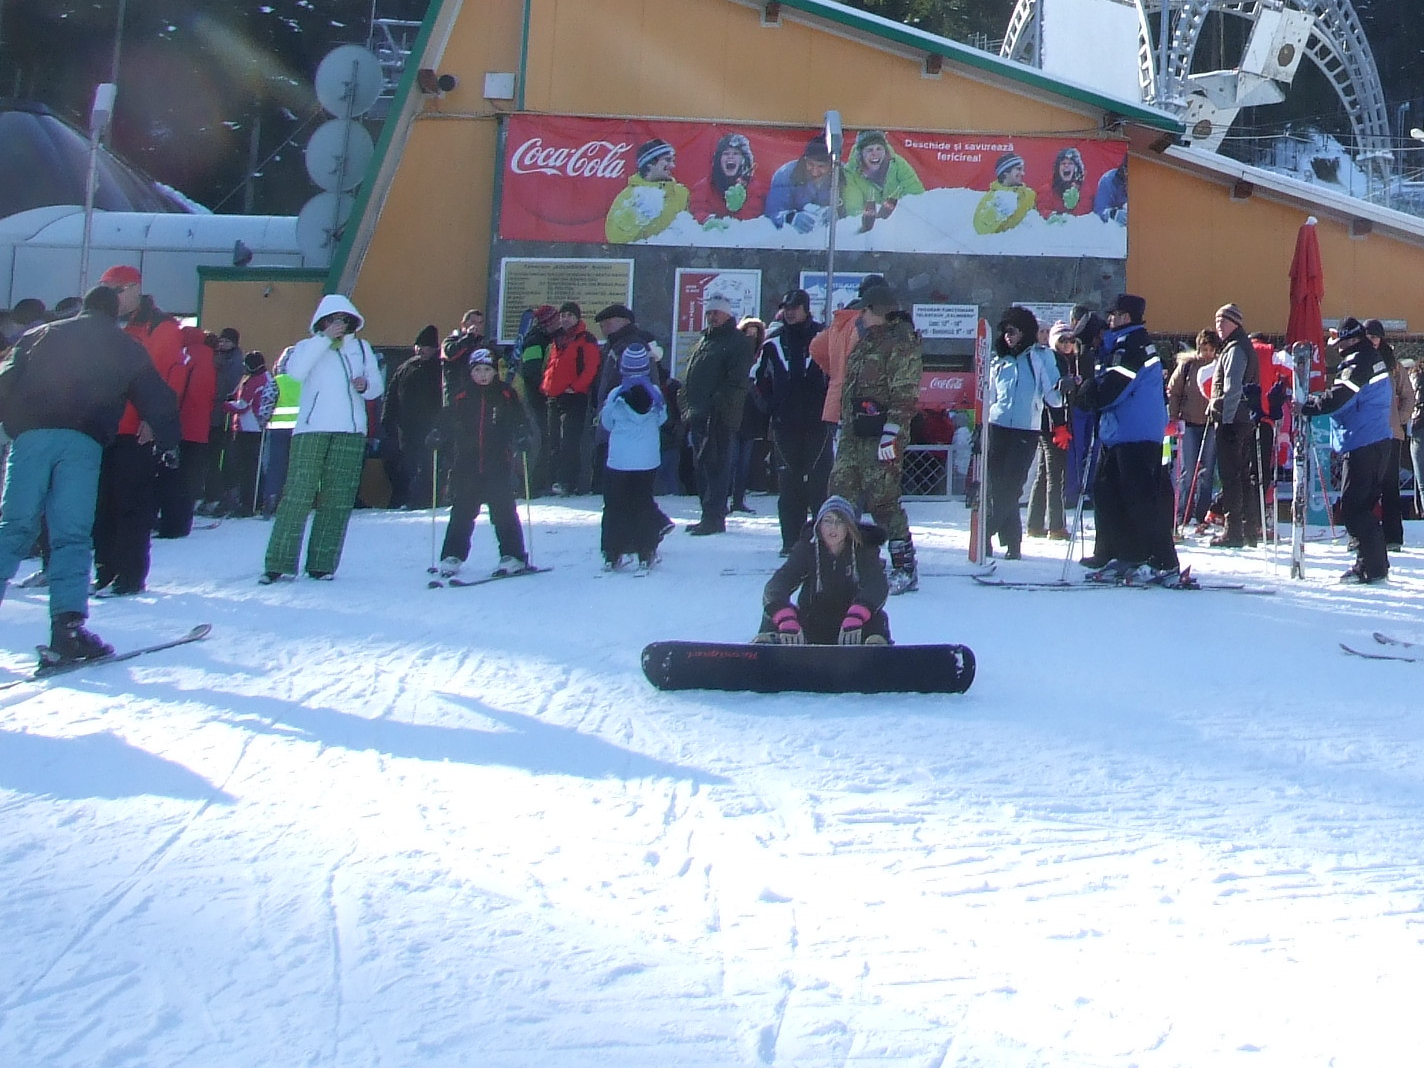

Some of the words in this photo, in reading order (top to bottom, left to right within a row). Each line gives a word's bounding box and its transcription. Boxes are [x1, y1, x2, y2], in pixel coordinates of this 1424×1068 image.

[904, 139, 951, 150] Deschide
[964, 142, 1014, 152] savurează
[511, 138, 633, 178] Coca-Cola
[937, 152, 982, 163] fericirea!
[976, 336, 986, 401] FISCHER
[930, 377, 964, 389] Coca-Cola
